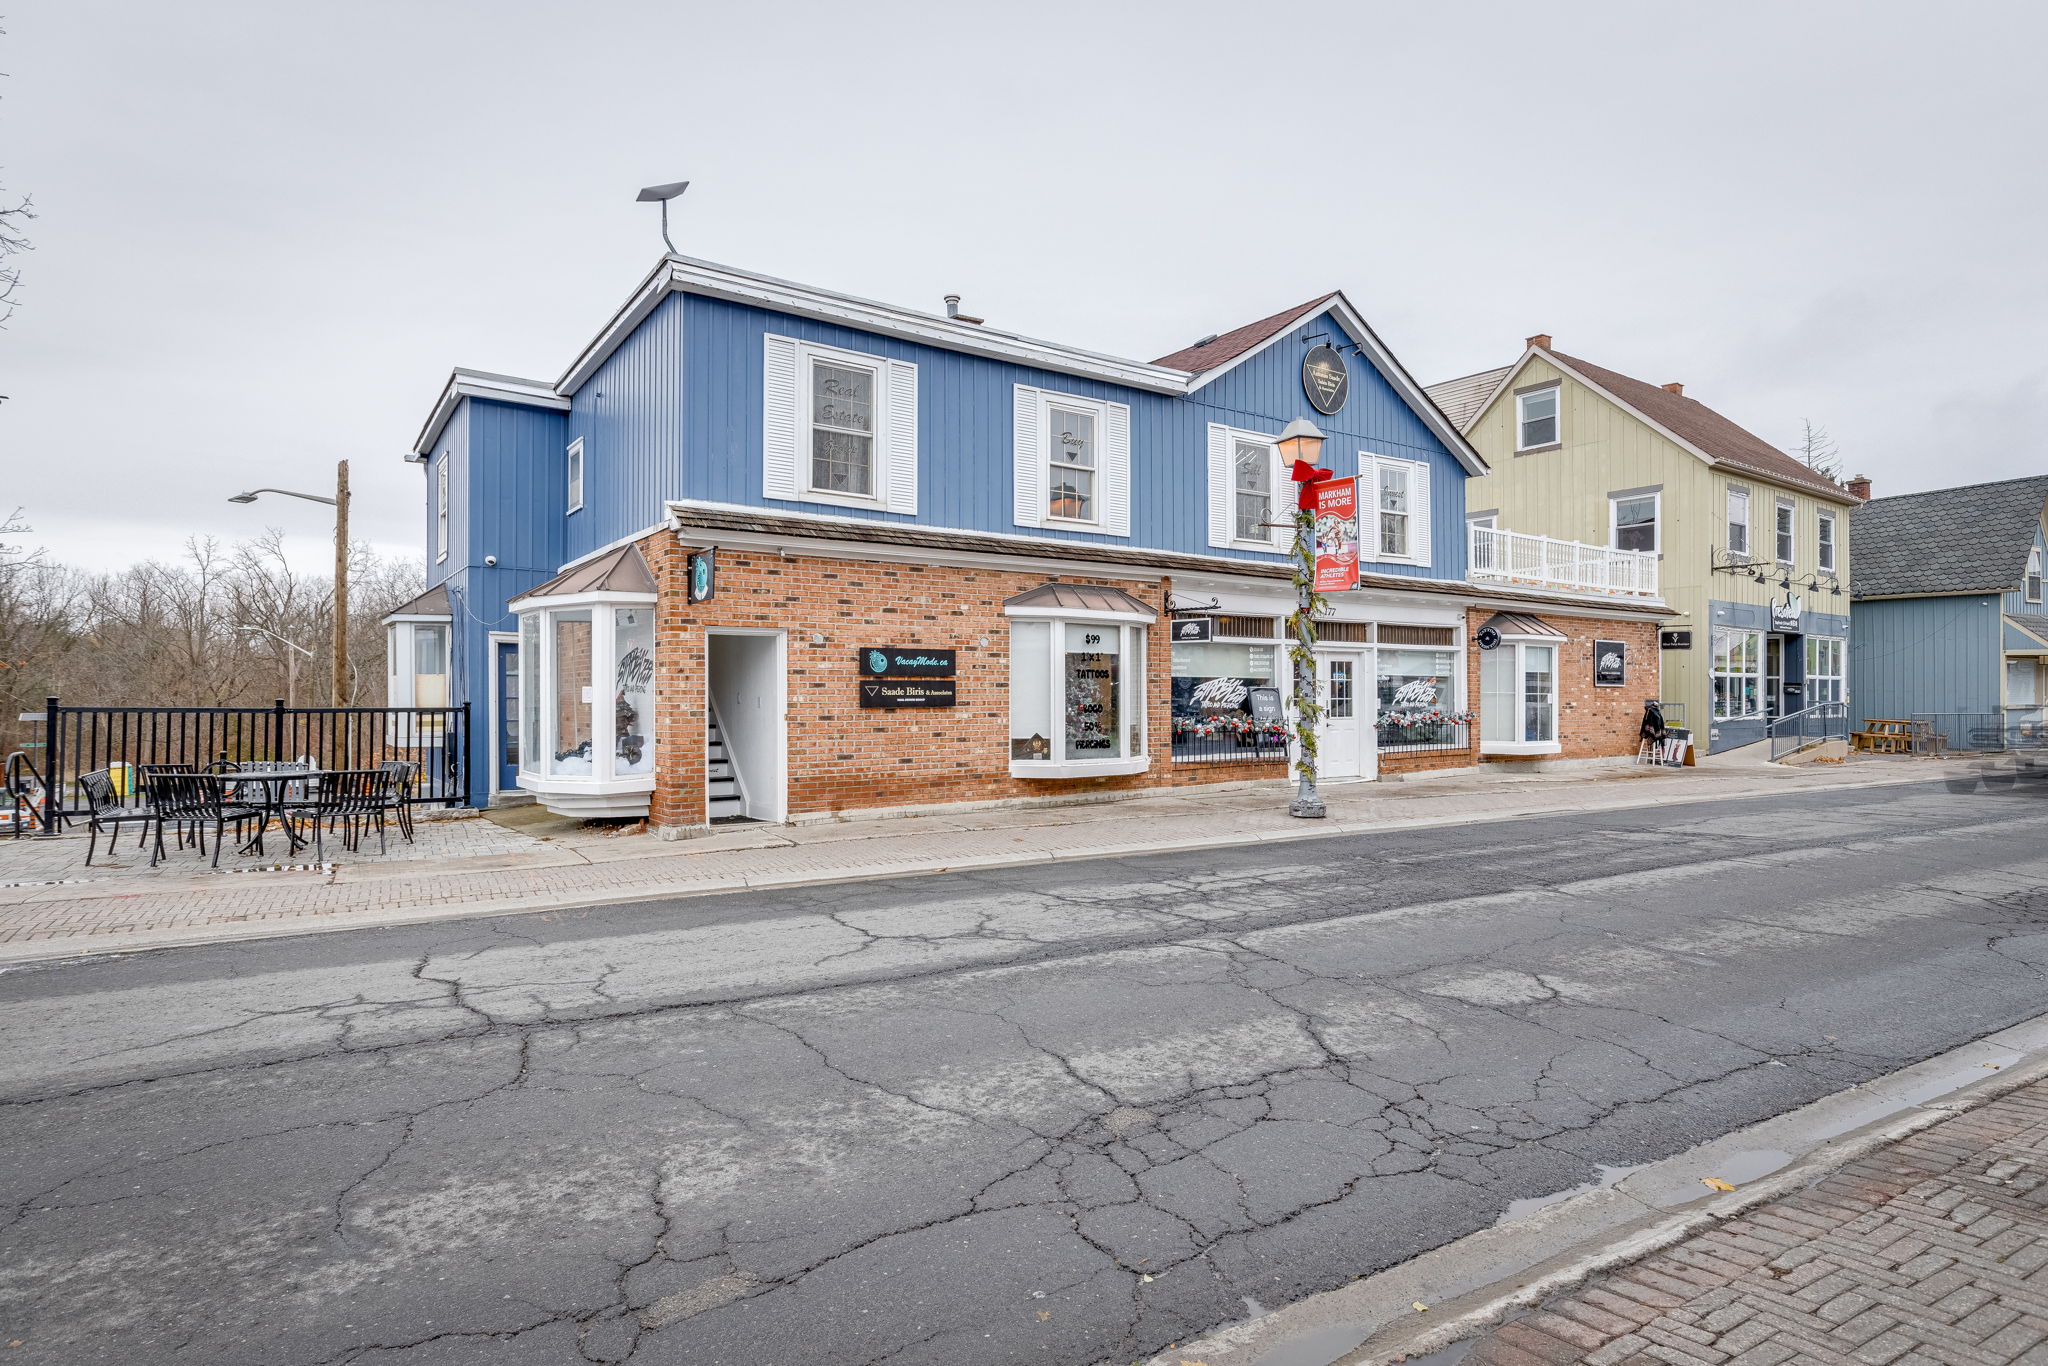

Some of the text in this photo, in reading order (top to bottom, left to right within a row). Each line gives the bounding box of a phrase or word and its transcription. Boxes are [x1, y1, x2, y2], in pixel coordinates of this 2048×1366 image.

[824, 379, 862, 398] Real
[822, 404, 864, 424] Estate
[1061, 432, 1085, 450] Buy
[1318, 488, 1351, 501] MARKHAM
[1318, 498, 1352, 510] IS MORE
[1324, 608, 1336, 616] 177
[1086, 633, 1100, 644] $99
[895, 656, 948, 668] VacayMode.ca
[1076, 670, 1109, 678] TATTOOS
[882, 687, 904, 696] Saade
[906, 687, 924, 696] Biris
[1264, 705, 1276, 713] sign
